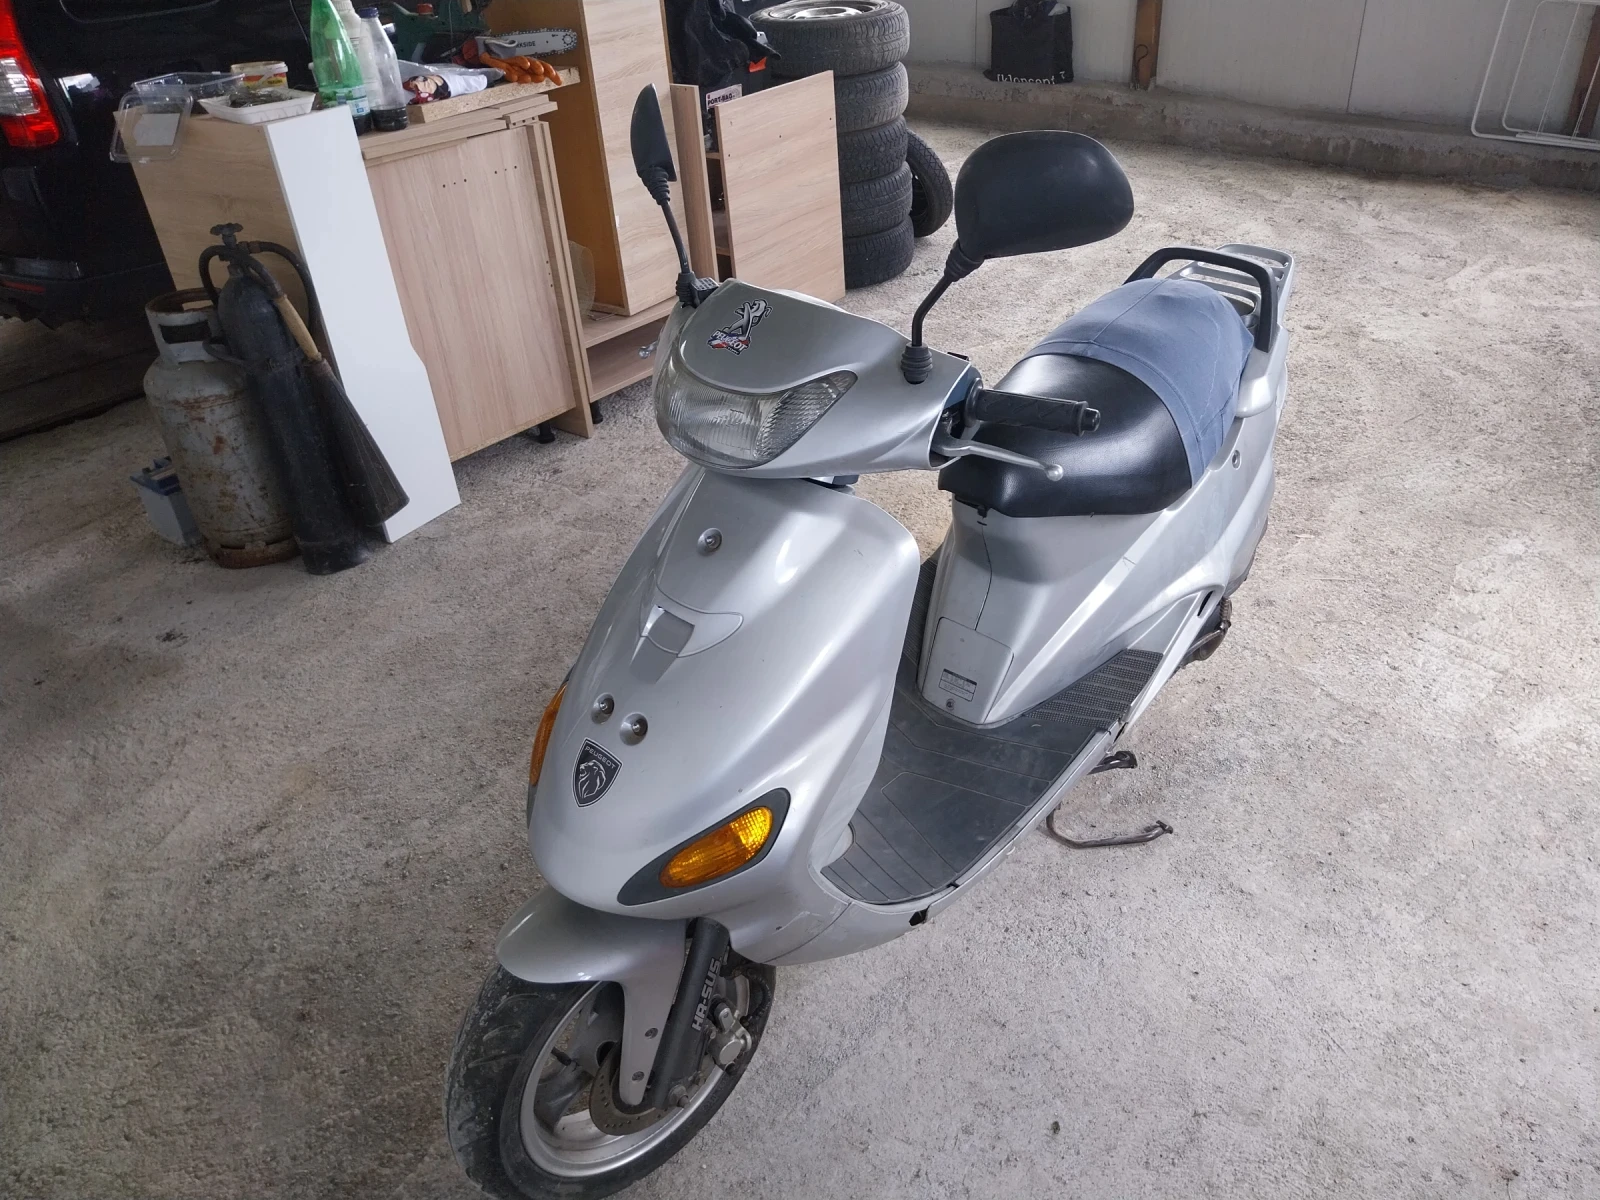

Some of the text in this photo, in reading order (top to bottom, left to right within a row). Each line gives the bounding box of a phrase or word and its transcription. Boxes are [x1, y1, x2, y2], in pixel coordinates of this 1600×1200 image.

[515, 41, 536, 49] RKSIDE
[712, 330, 748, 351] PEUGEOT
[585, 745, 616, 769] PEUGEOT
[691, 956, 722, 1032] HR-SUS
